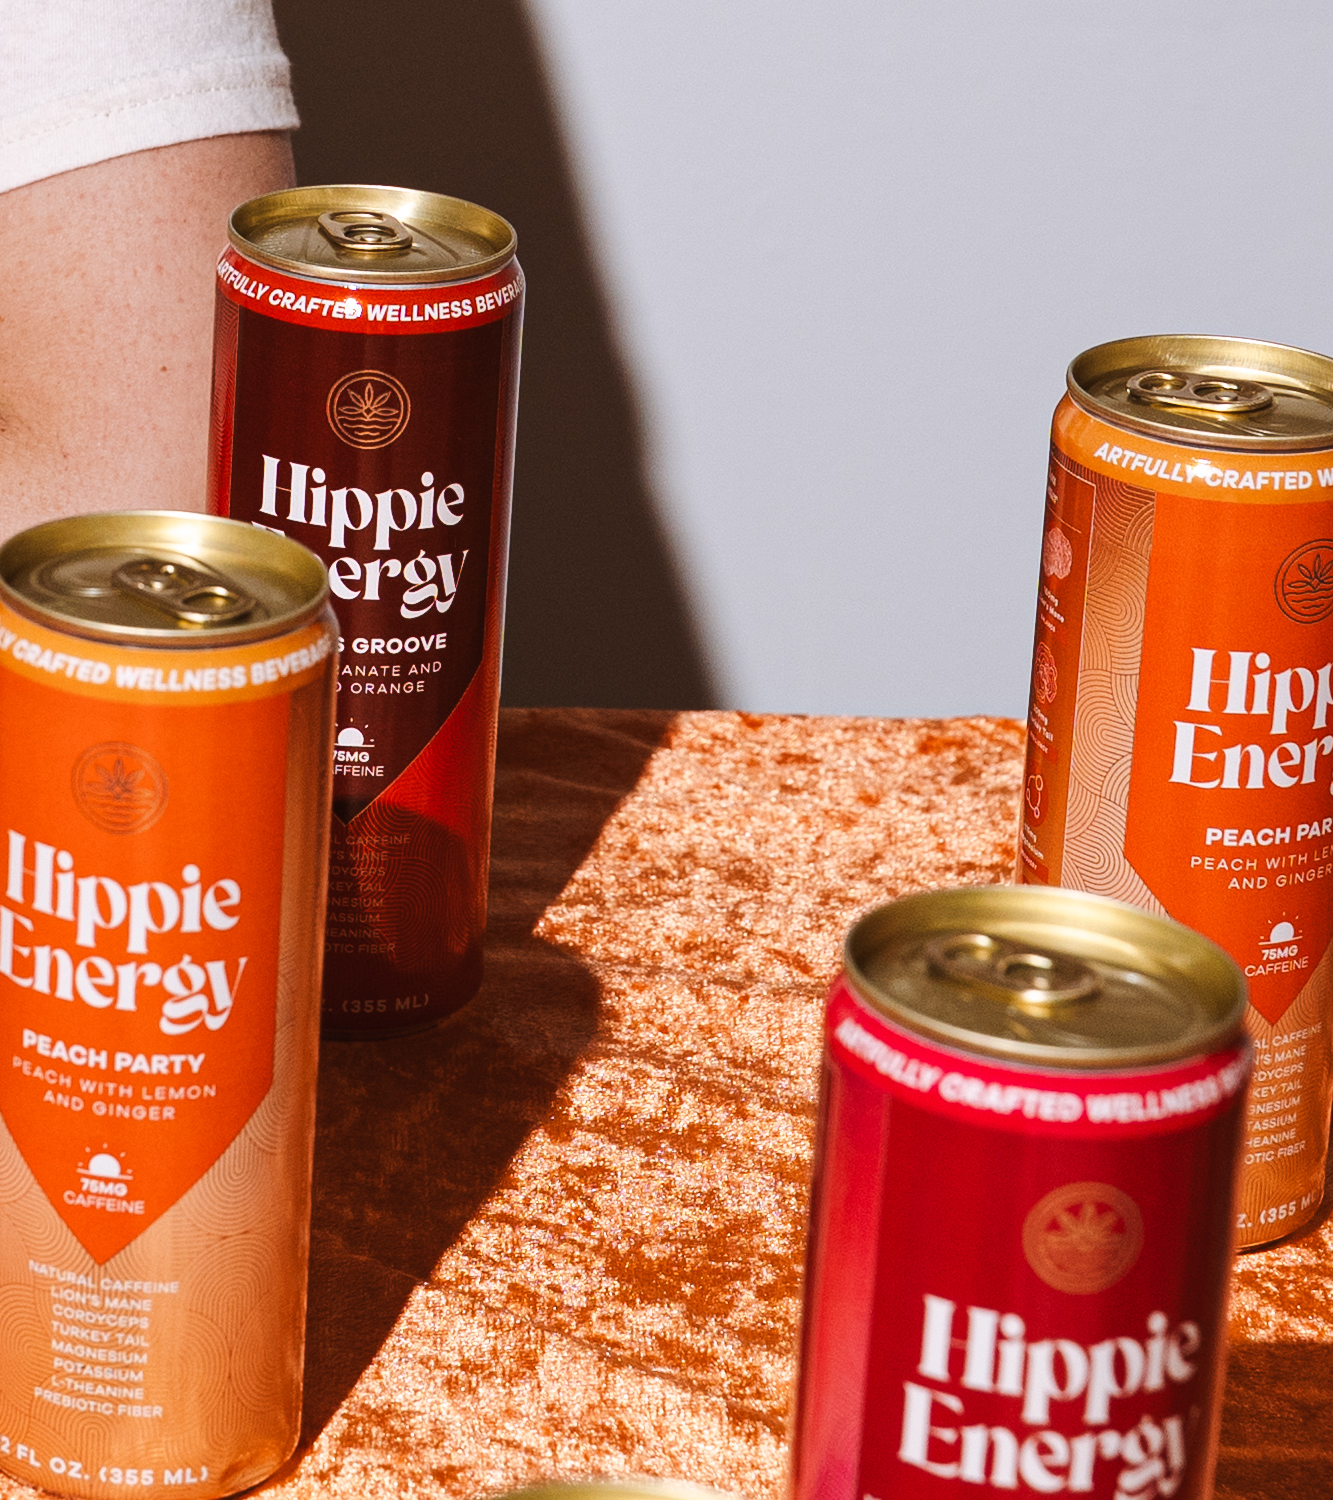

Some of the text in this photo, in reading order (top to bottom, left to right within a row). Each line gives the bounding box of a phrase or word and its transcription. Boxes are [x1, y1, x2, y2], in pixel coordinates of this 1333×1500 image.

[268, 288, 362, 319] CRAFTED
[367, 300, 473, 322] WELLNESS
[1094, 442, 1313, 491] ARTFULLY CRAFTED
[259, 454, 465, 551] Hippie
[352, 633, 448, 654] GROOVE
[13, 636, 247, 692] CRAFTED WELLNESS
[408, 661, 442, 675] AND
[350, 681, 425, 694] ORANGE
[1186, 647, 1333, 734] Hipp
[1169, 720, 1333, 796] Ener
[1205, 817, 1333, 848] PEACH PAR
[1191, 852, 1308, 871] PEACH WITH
[6, 829, 242, 955] Hippie
[1228, 874, 1269, 889] AND
[1244, 956, 1309, 979] CAFFEINE
[1261, 945, 1298, 961] 75MG
[22, 1028, 205, 1075] PEACH PARTY
[12, 1056, 217, 1101] PEACH WITH LEMON
[43, 1089, 176, 1122] AND GINGER
[63, 1190, 146, 1215] CAFFEINE
[80, 1177, 129, 1197] 75MG
[917, 1294, 1201, 1426] Hippie
